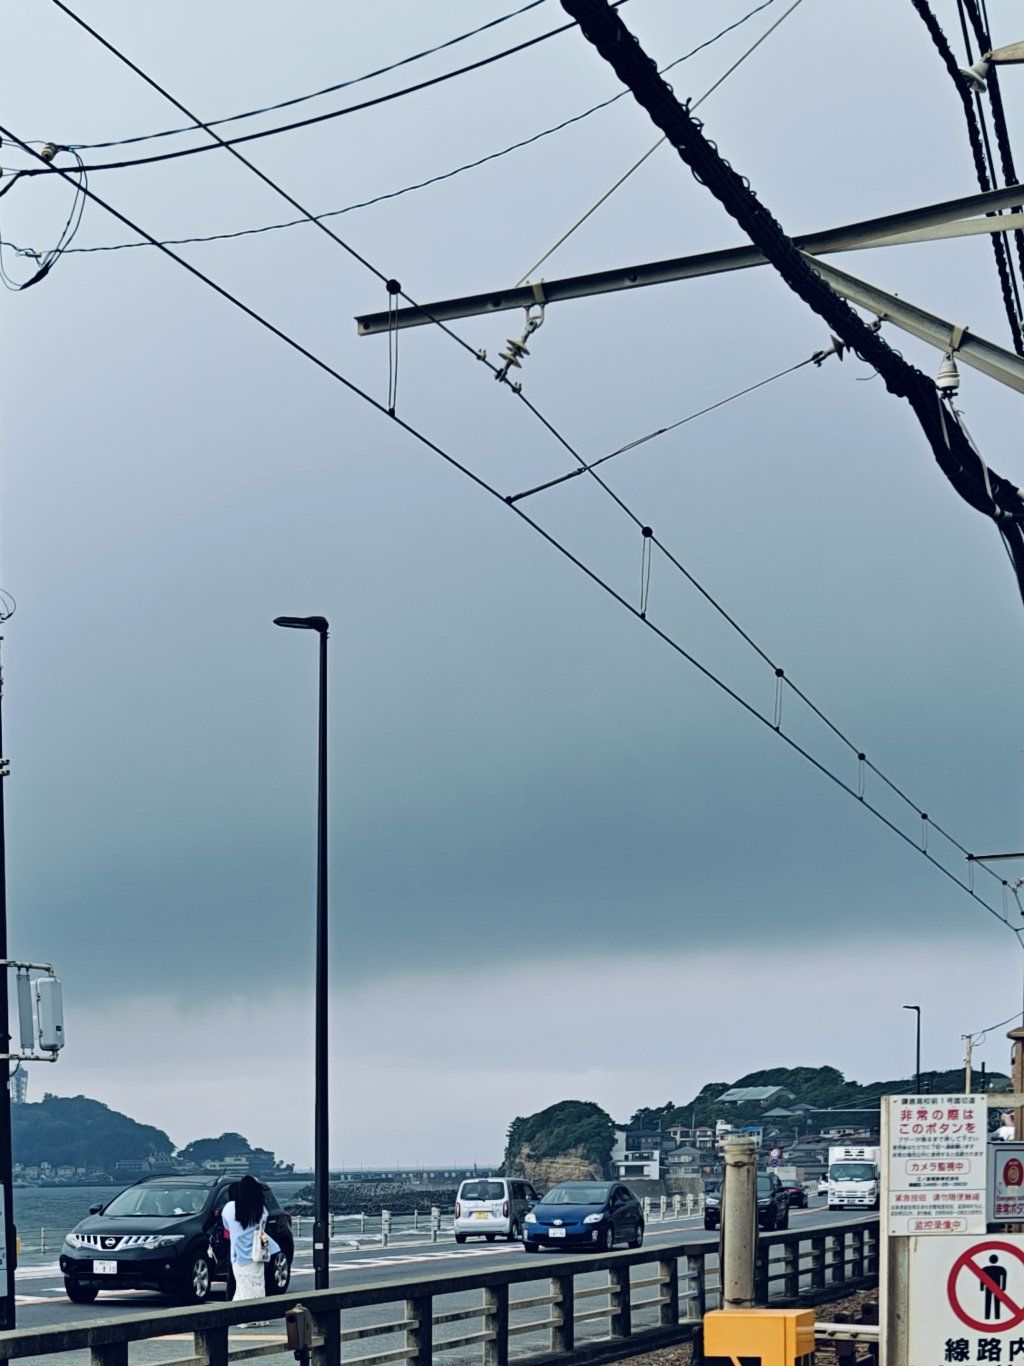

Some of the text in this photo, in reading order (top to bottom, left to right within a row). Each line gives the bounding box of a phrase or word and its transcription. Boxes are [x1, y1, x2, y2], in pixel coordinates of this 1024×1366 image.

[901, 1109, 974, 1121] 非常の際は
[899, 1122, 975, 1134] このボタンを
[912, 1162, 964, 1171] カメラ監視中
[996, 1203, 1024, 1215] 非常ボタ
